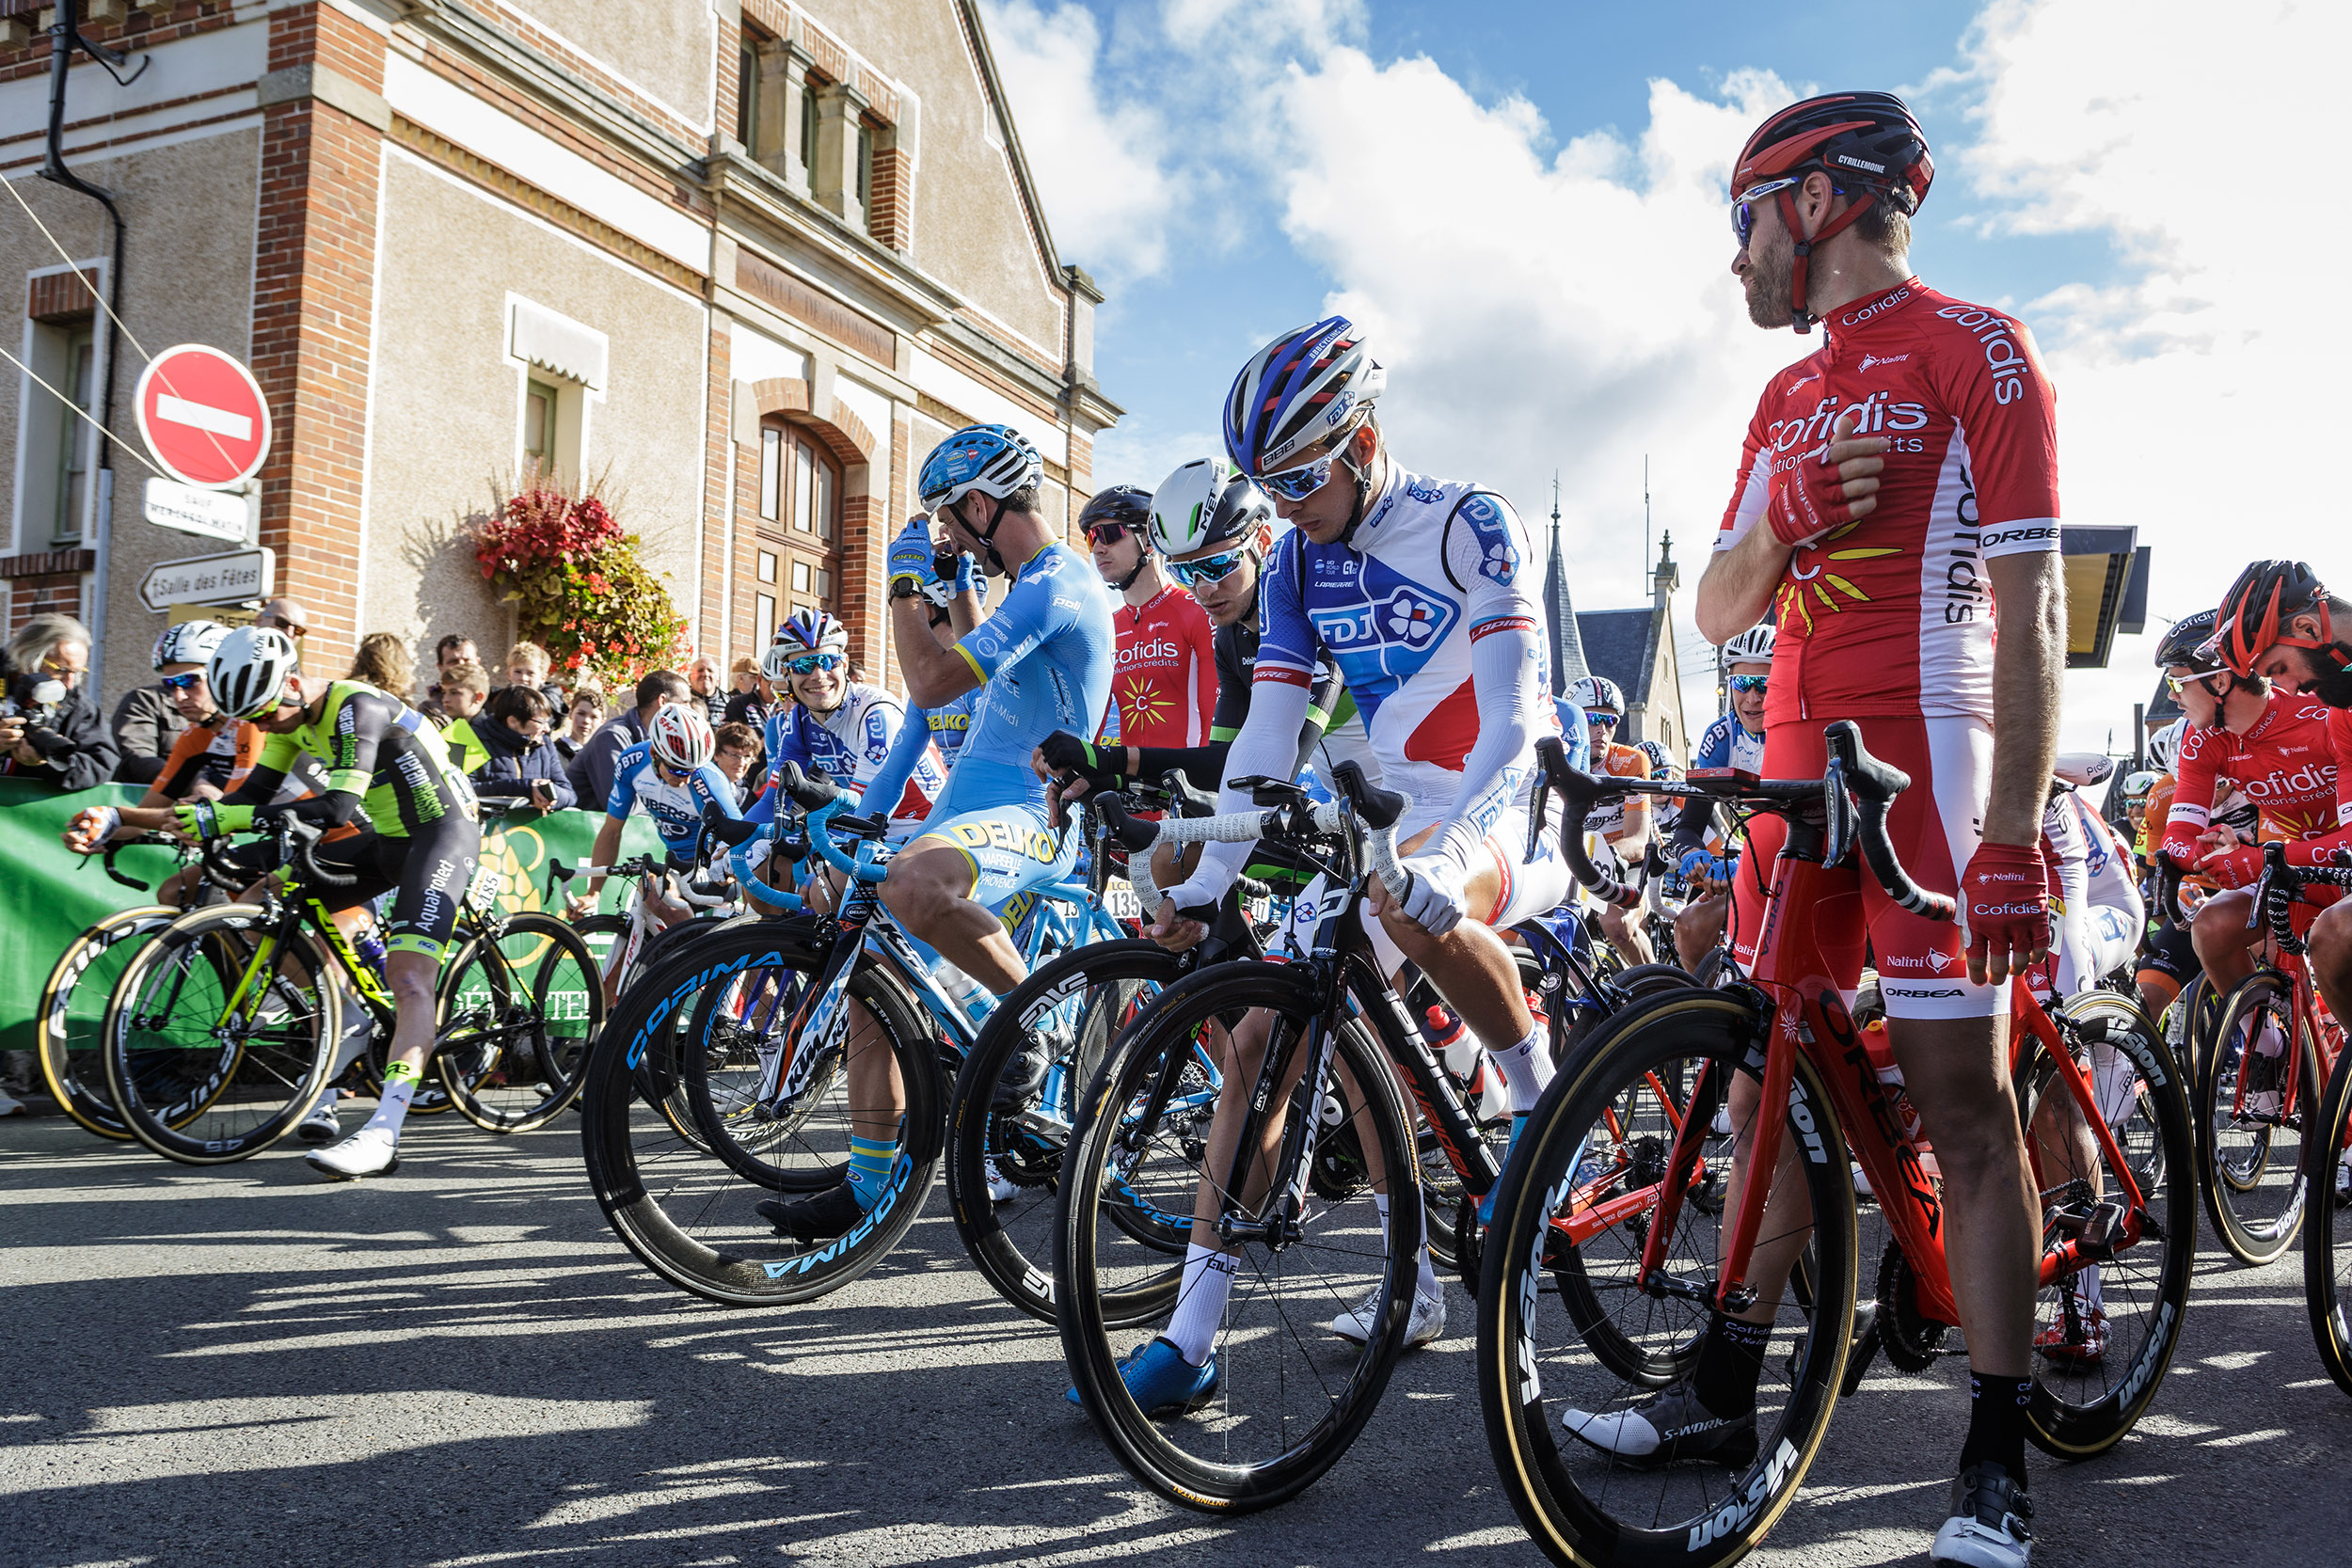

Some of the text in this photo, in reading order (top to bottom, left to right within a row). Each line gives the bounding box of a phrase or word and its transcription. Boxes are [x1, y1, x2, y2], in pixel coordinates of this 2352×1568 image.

[804, 293, 821, 325] DE
[1841, 286, 1911, 325] Cofidis
[1935, 305, 2028, 406] Cofidis
[1328, 406, 1345, 425] FDJ
[1263, 439, 1295, 467] BBB
[1200, 488, 1217, 531] MET
[1463, 496, 1503, 532] FDJ
[159, 567, 258, 597] Salle des Fêtes
[1149, 589, 1172, 609] Cofidis
[1318, 614, 1374, 643] FDJ
[2169, 610, 2217, 639] Cofidis
[994, 634, 1032, 675] SRAM
[1144, 658, 1179, 669] crédits
[1136, 696, 1149, 711] C
[338, 704, 360, 768] veranclassic
[867, 711, 884, 739] FDJ
[1700, 721, 1732, 757] HP BT
[2249, 710, 2278, 739] Cofidis
[622, 752, 644, 769] BTP
[394, 750, 450, 824] veranclassic
[2301, 784, 2338, 802] crédi
[949, 819, 1057, 865] DELKO
[980, 877, 1018, 890] PROVENCE
[1112, 881, 1133, 891] LCL
[1993, 872, 2026, 882] Nalini
[415, 858, 456, 932] AquaProtect
[1112, 891, 1140, 917] 135
[1974, 903, 2042, 915] Cofidis
[2048, 897, 2063, 913] CL
[1761, 879, 1784, 957] ORBEA
[626, 933, 639, 967] TIME
[1886, 955, 1924, 968] Nalini
[1885, 988, 1965, 998] ORBEA
[627, 951, 785, 1070] CORIMA
[788, 1036, 821, 1094] KTM
[1820, 990, 1942, 1241] ORBEA
[763, 1152, 914, 1279] CORIMA
[1724, 1322, 1771, 1336] Cofidi
[1171, 1483, 1237, 1508] CONTINENTAL
